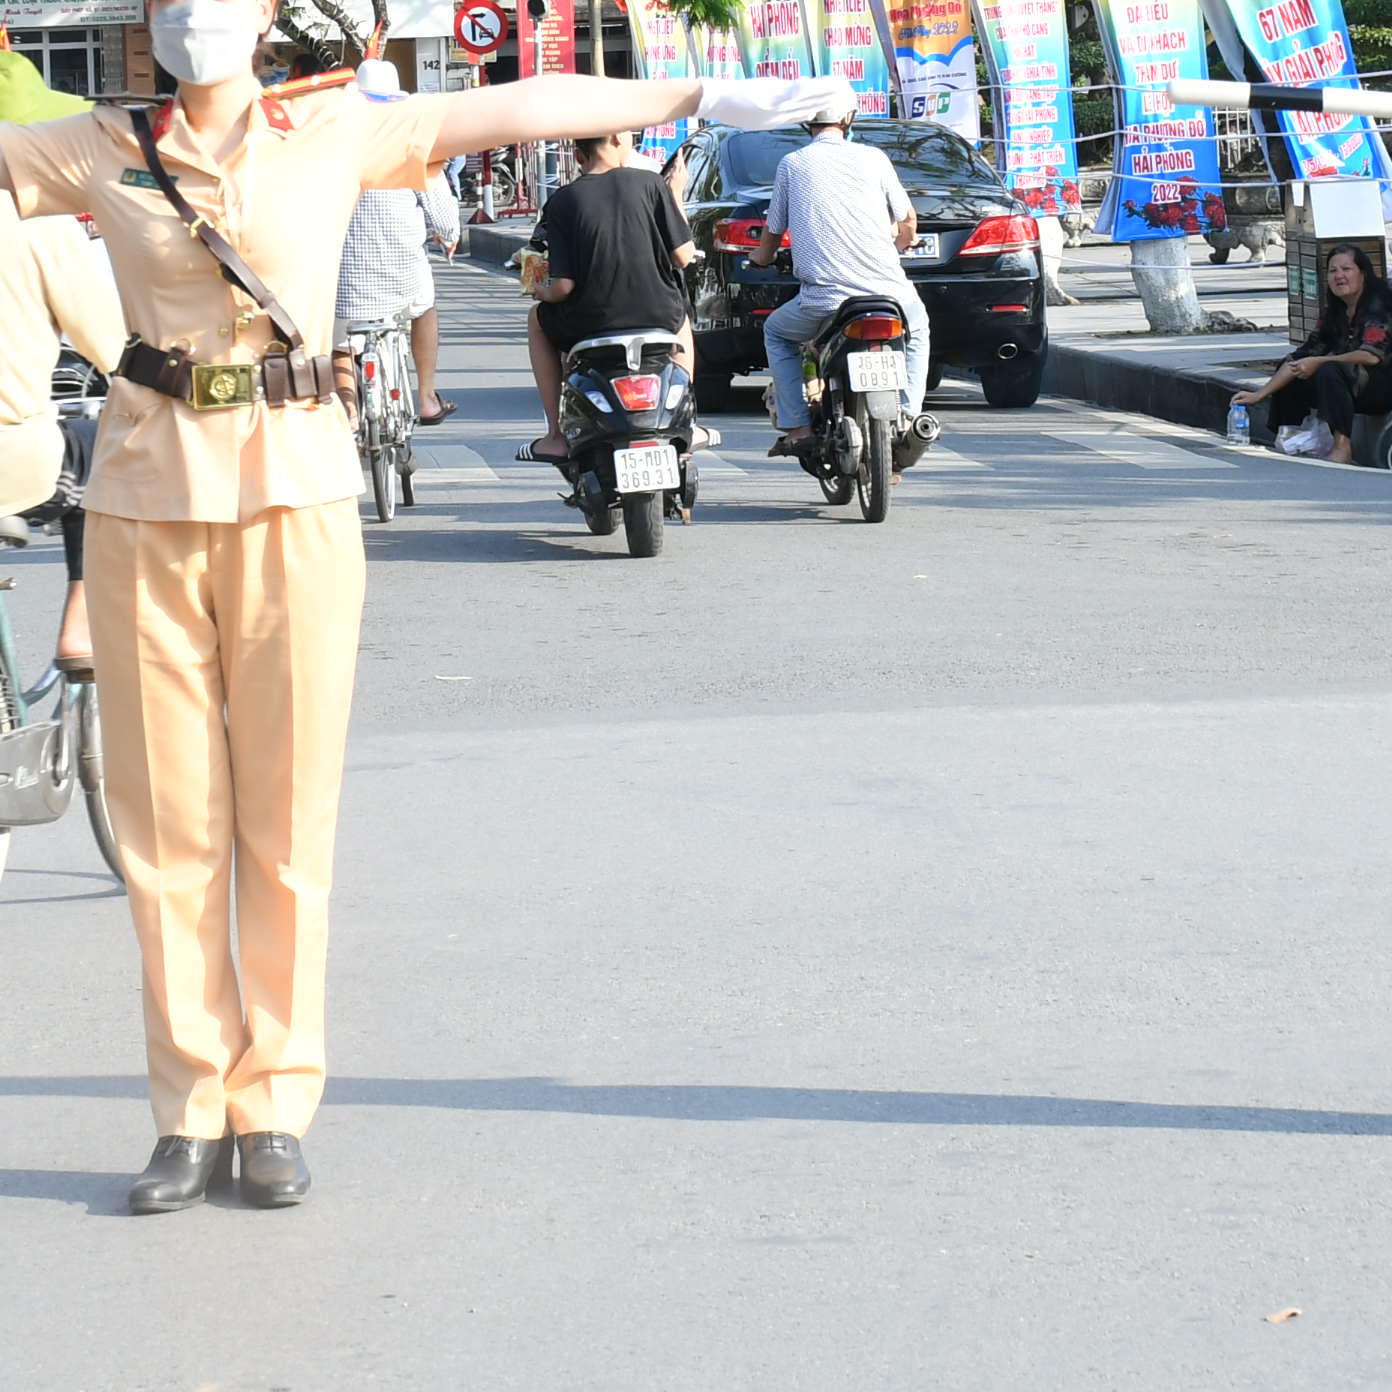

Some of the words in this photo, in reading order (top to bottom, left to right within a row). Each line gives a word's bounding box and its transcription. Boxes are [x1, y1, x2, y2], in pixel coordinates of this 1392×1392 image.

[1258, 8, 1279, 42] 67
[423, 60, 441, 71] 142
[1133, 148, 1153, 174] HẢI
[1155, 147, 1193, 171] PHÒNG
[1153, 183, 1180, 202] 2022
[860, 371, 899, 388] 0891
